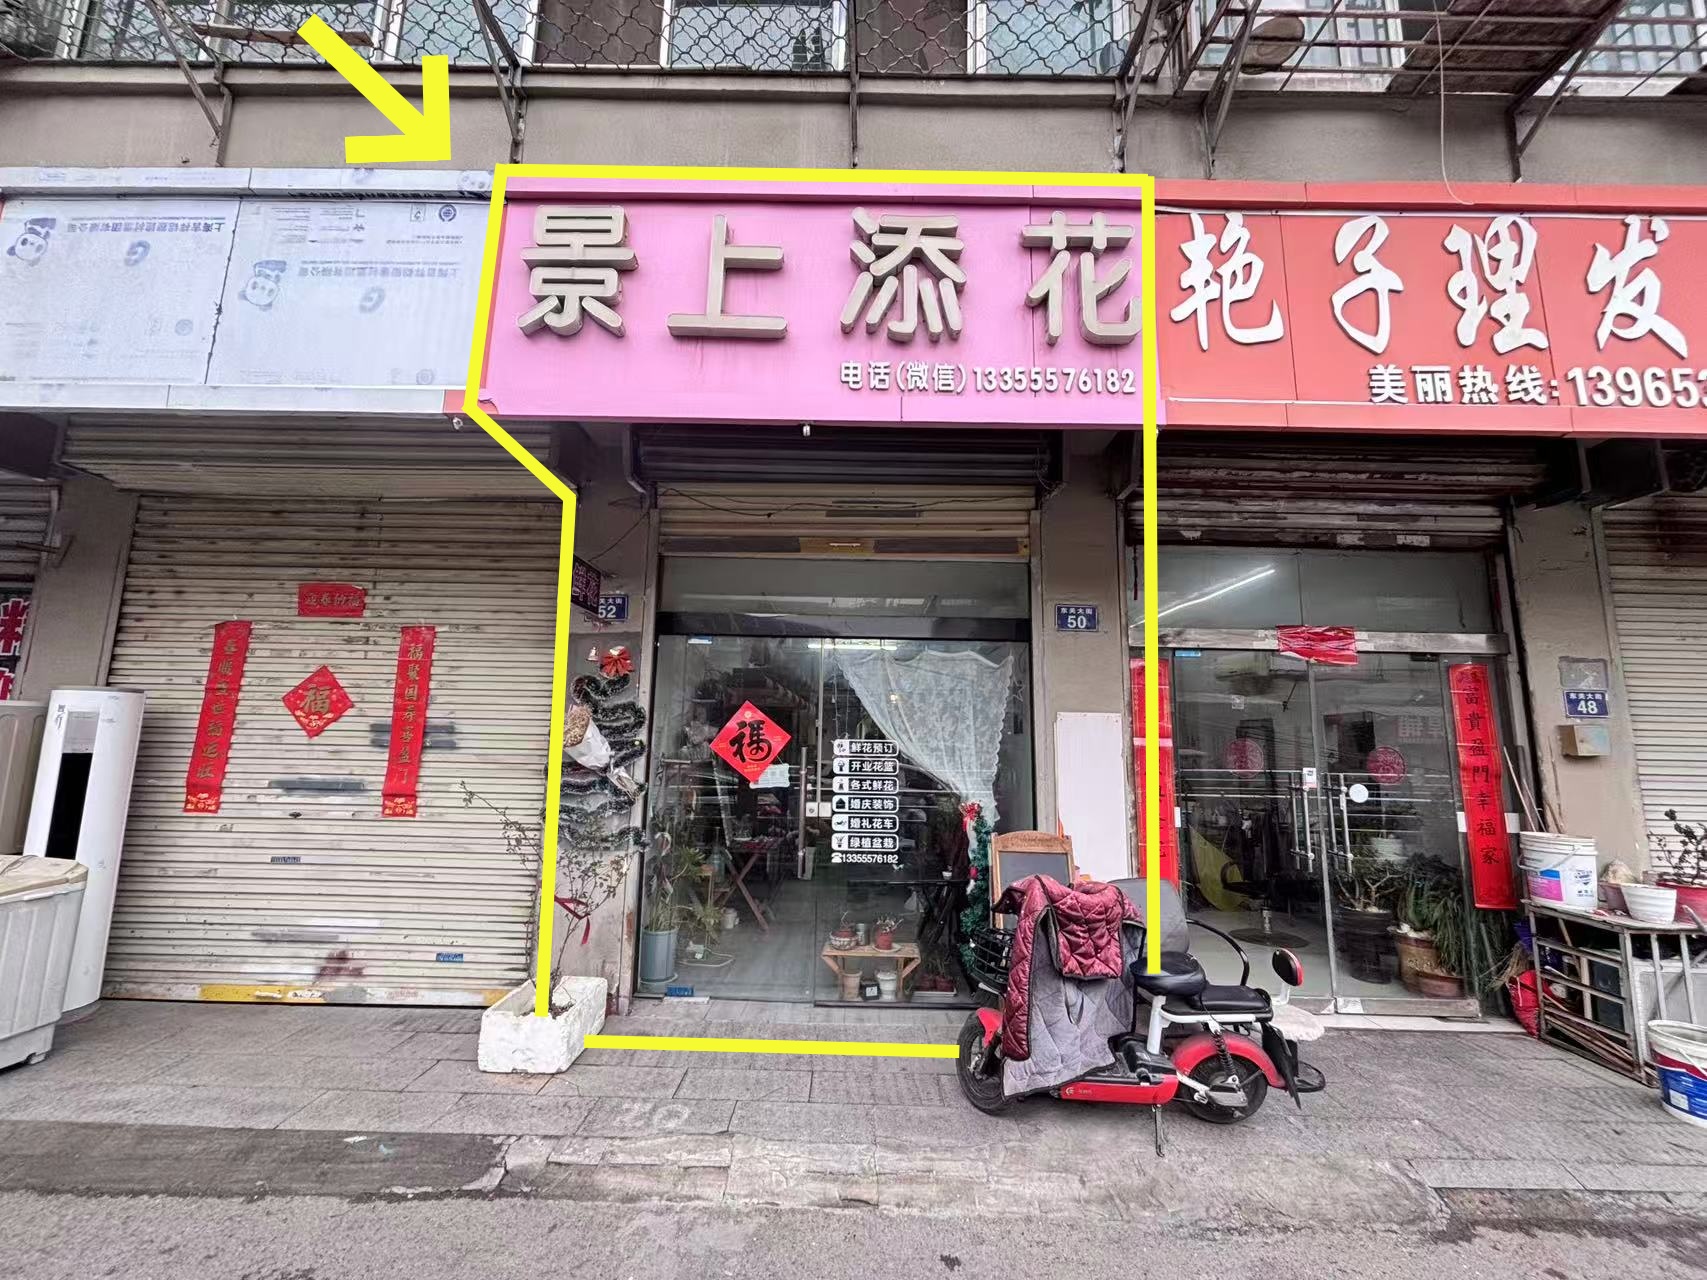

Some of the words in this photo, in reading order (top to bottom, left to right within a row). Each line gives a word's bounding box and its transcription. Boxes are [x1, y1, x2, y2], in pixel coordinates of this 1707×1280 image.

[515, 203, 1142, 345] 景上添花
[1169, 211, 1689, 359] 艳子理发
[598, 605, 617, 619] 52
[1067, 615, 1087, 629] 50
[299, 683, 332, 715] 福
[1577, 700, 1598, 714] 48
[729, 719, 772, 763] 福
[850, 742, 894, 753] 鲜花预订
[850, 761, 894, 772] 开业花篮
[850, 780, 894, 791] 各式鲜花
[850, 798, 894, 810] 婚庆装饰
[850, 818, 894, 829] 婚礼花车
[849, 836, 894, 848] 绿植盆栽
[842, 854, 899, 864] 13355576182
